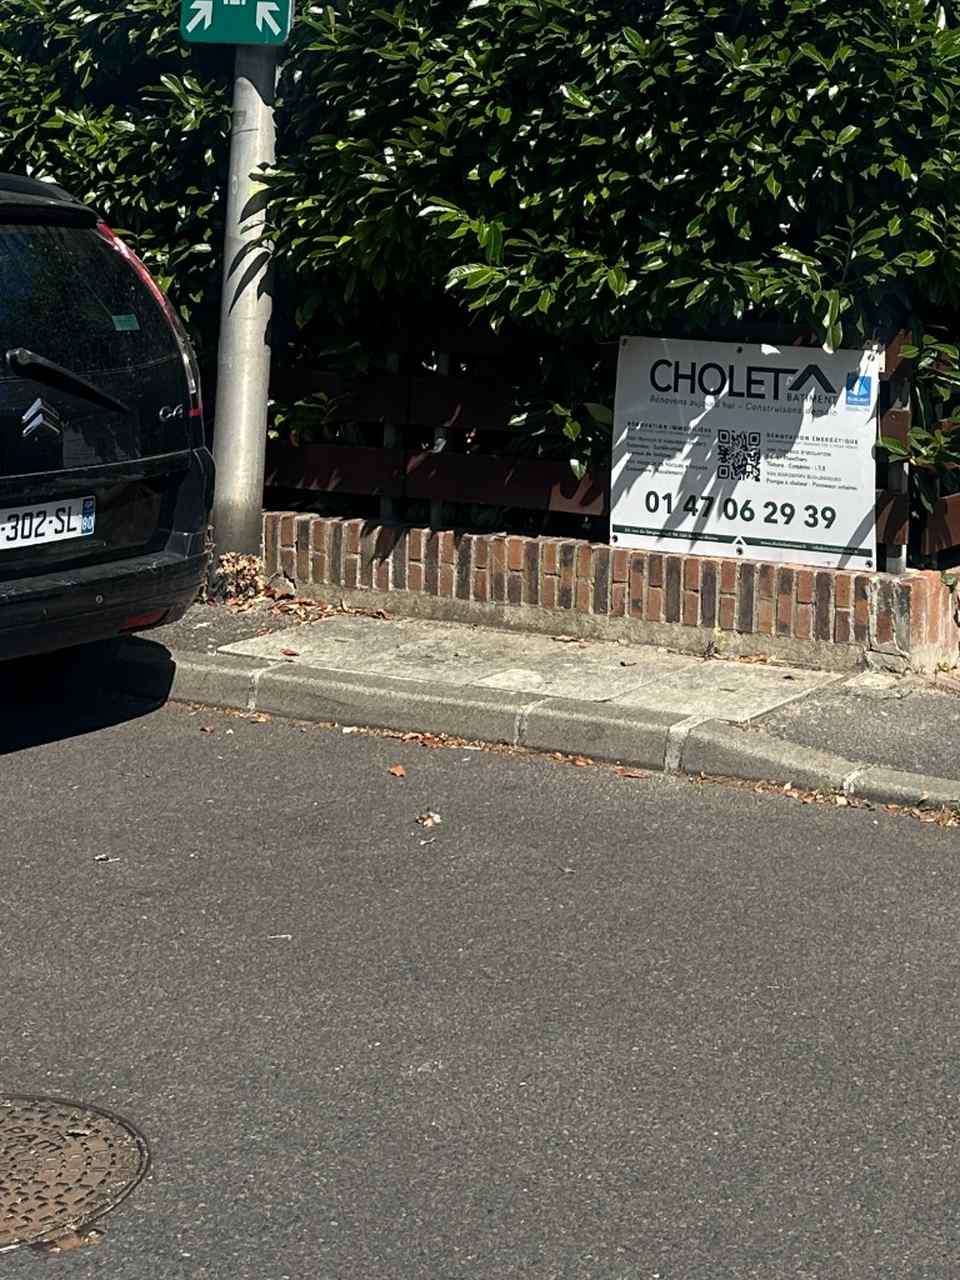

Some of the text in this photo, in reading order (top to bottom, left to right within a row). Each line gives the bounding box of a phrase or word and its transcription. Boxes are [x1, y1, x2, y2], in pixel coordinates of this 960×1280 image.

[650, 359, 799, 401] CHOLET
[645, 490, 837, 529] 01 47 06 29 39
